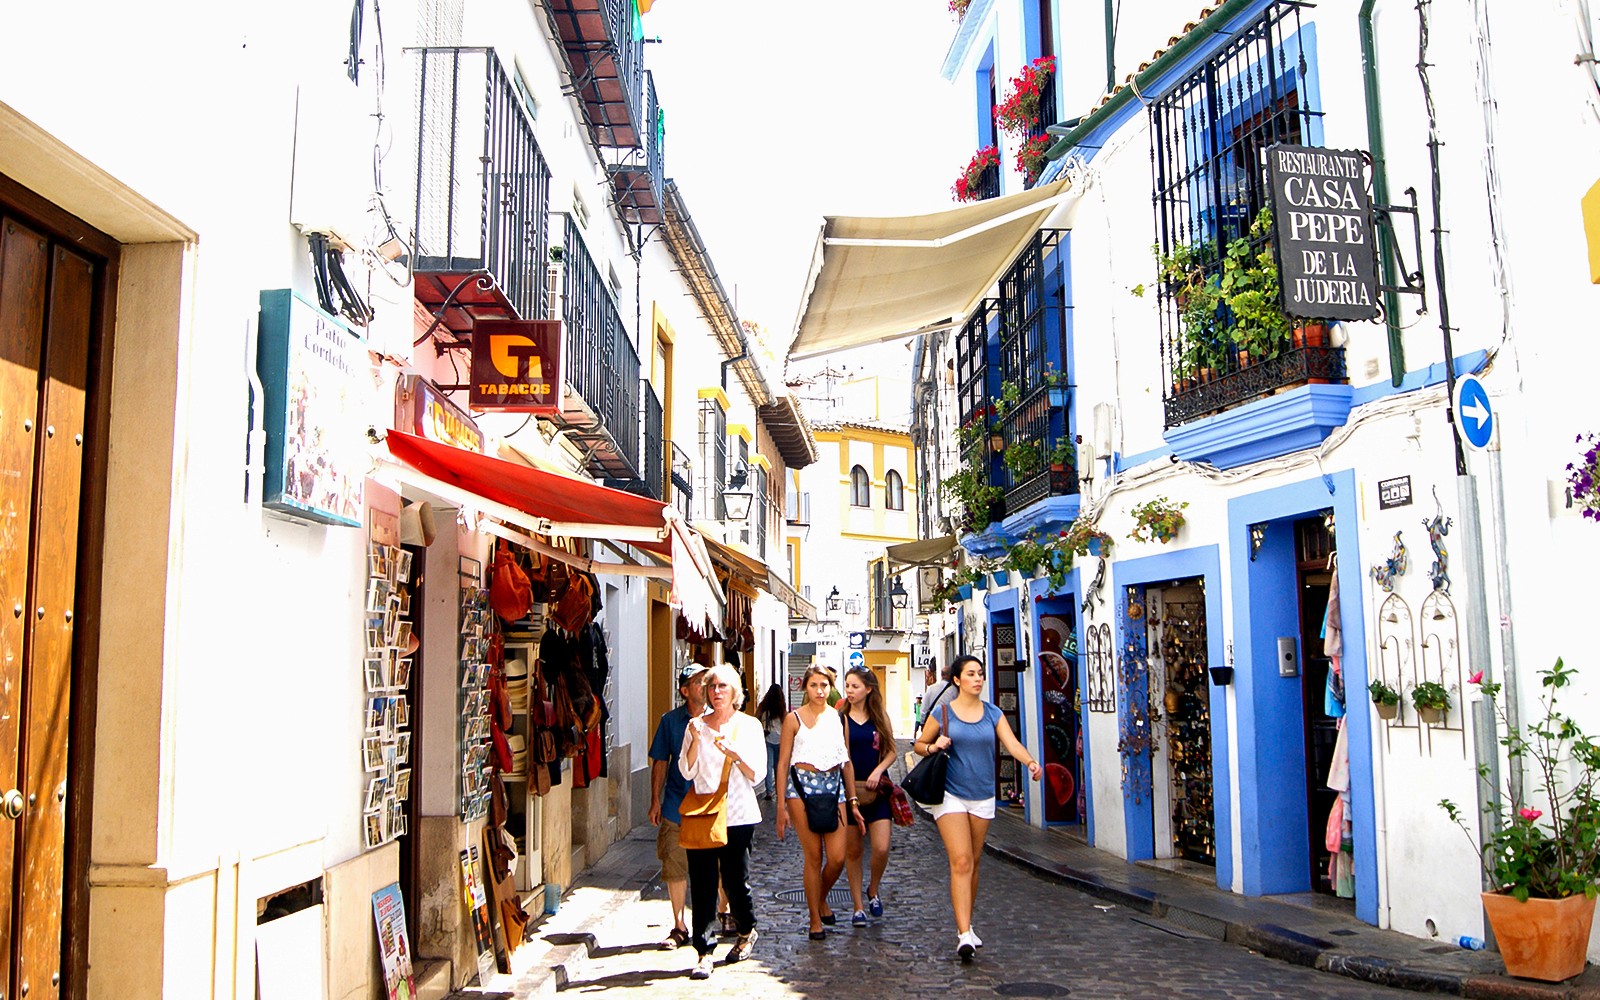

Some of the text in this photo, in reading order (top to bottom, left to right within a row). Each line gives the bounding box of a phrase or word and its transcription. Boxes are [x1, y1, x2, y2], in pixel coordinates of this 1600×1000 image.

[1277, 150, 1359, 179] RESTAURANTE
[1284, 176, 1362, 211] CASA
[1287, 211, 1364, 245] PEPE
[1302, 249, 1358, 277] DE LA
[479, 383, 551, 395] TABACOS
